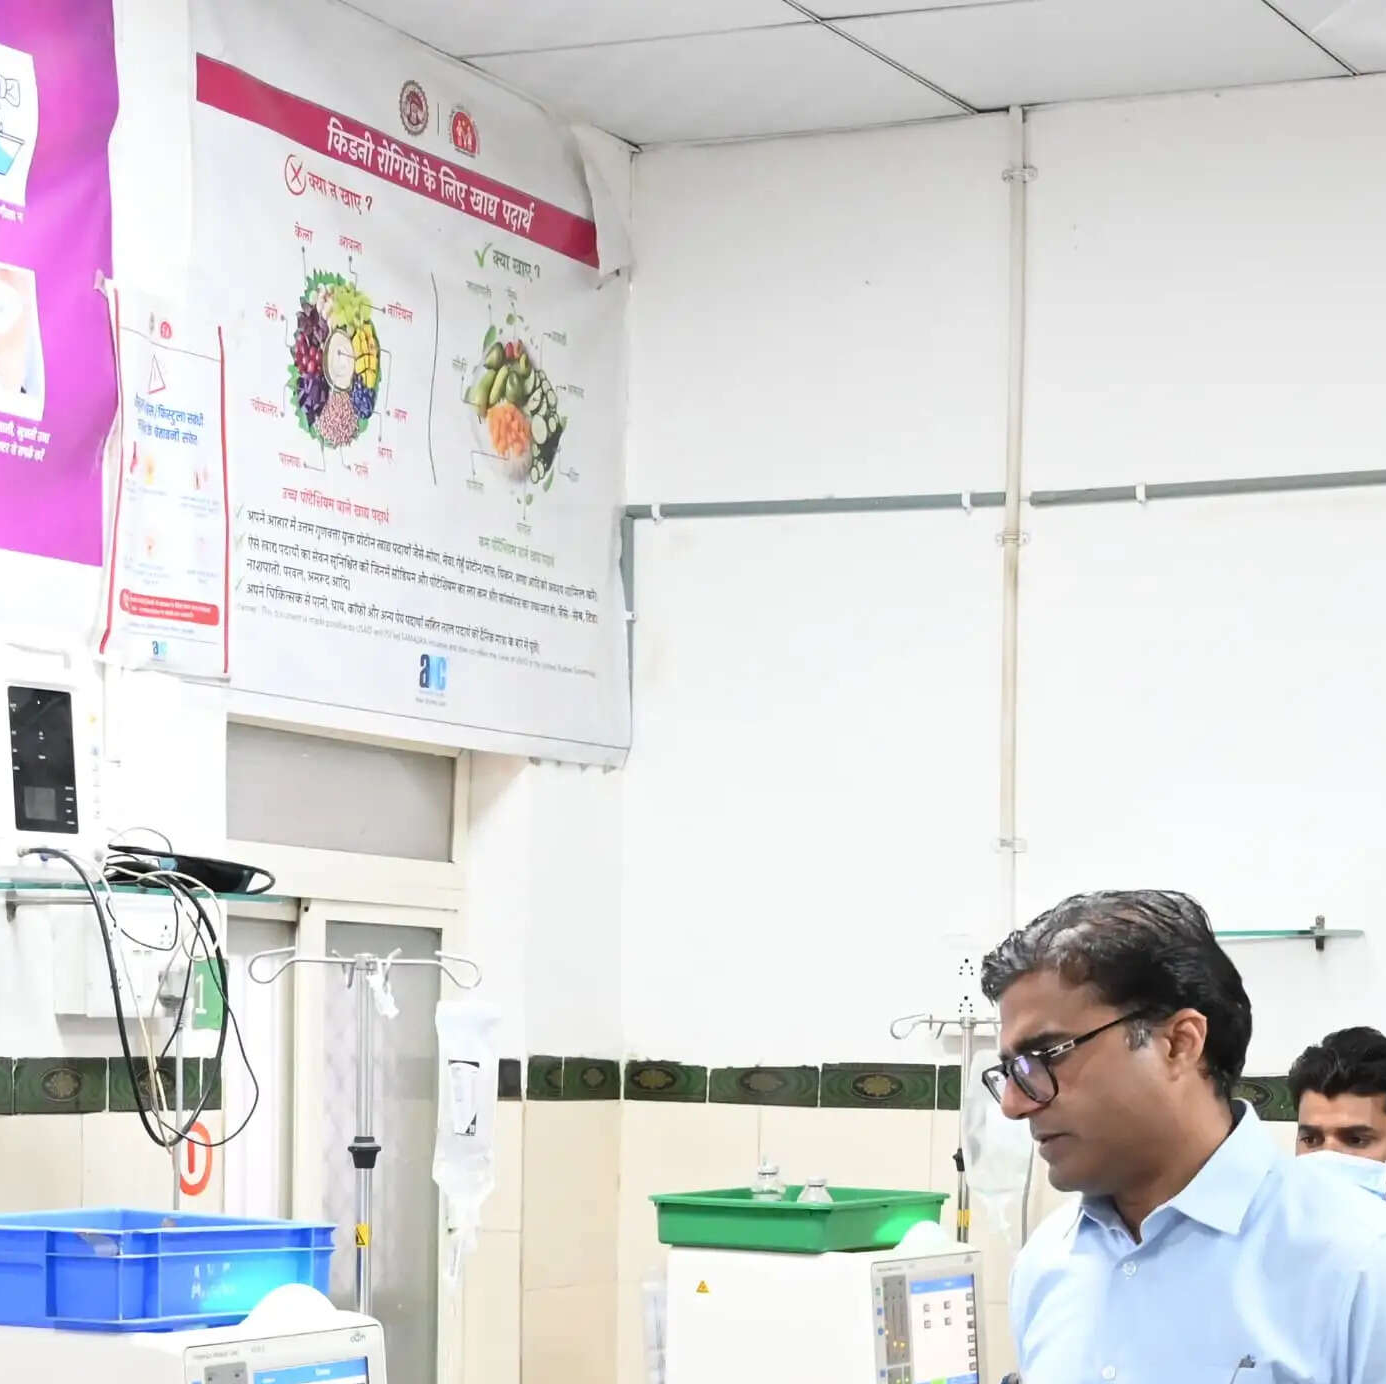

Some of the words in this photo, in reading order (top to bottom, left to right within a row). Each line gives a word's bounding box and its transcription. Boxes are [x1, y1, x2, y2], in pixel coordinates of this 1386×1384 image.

[307, 172, 327, 196] क्या
[327, 116, 375, 168] किडनी
[377, 140, 421, 187] रोगियों
[422, 158, 436, 192] के
[439, 166, 468, 210] लिए
[469, 184, 500, 220] खाद्य
[502, 201, 535, 233] पदार्थ
[294, 221, 313, 243] केला
[493, 249, 510, 271] क्या
[247, 509, 265, 521] अपने
[267, 515, 288, 529] आहार
[247, 582, 264, 598] अपने
[195, 974, 207, 1014] 1
